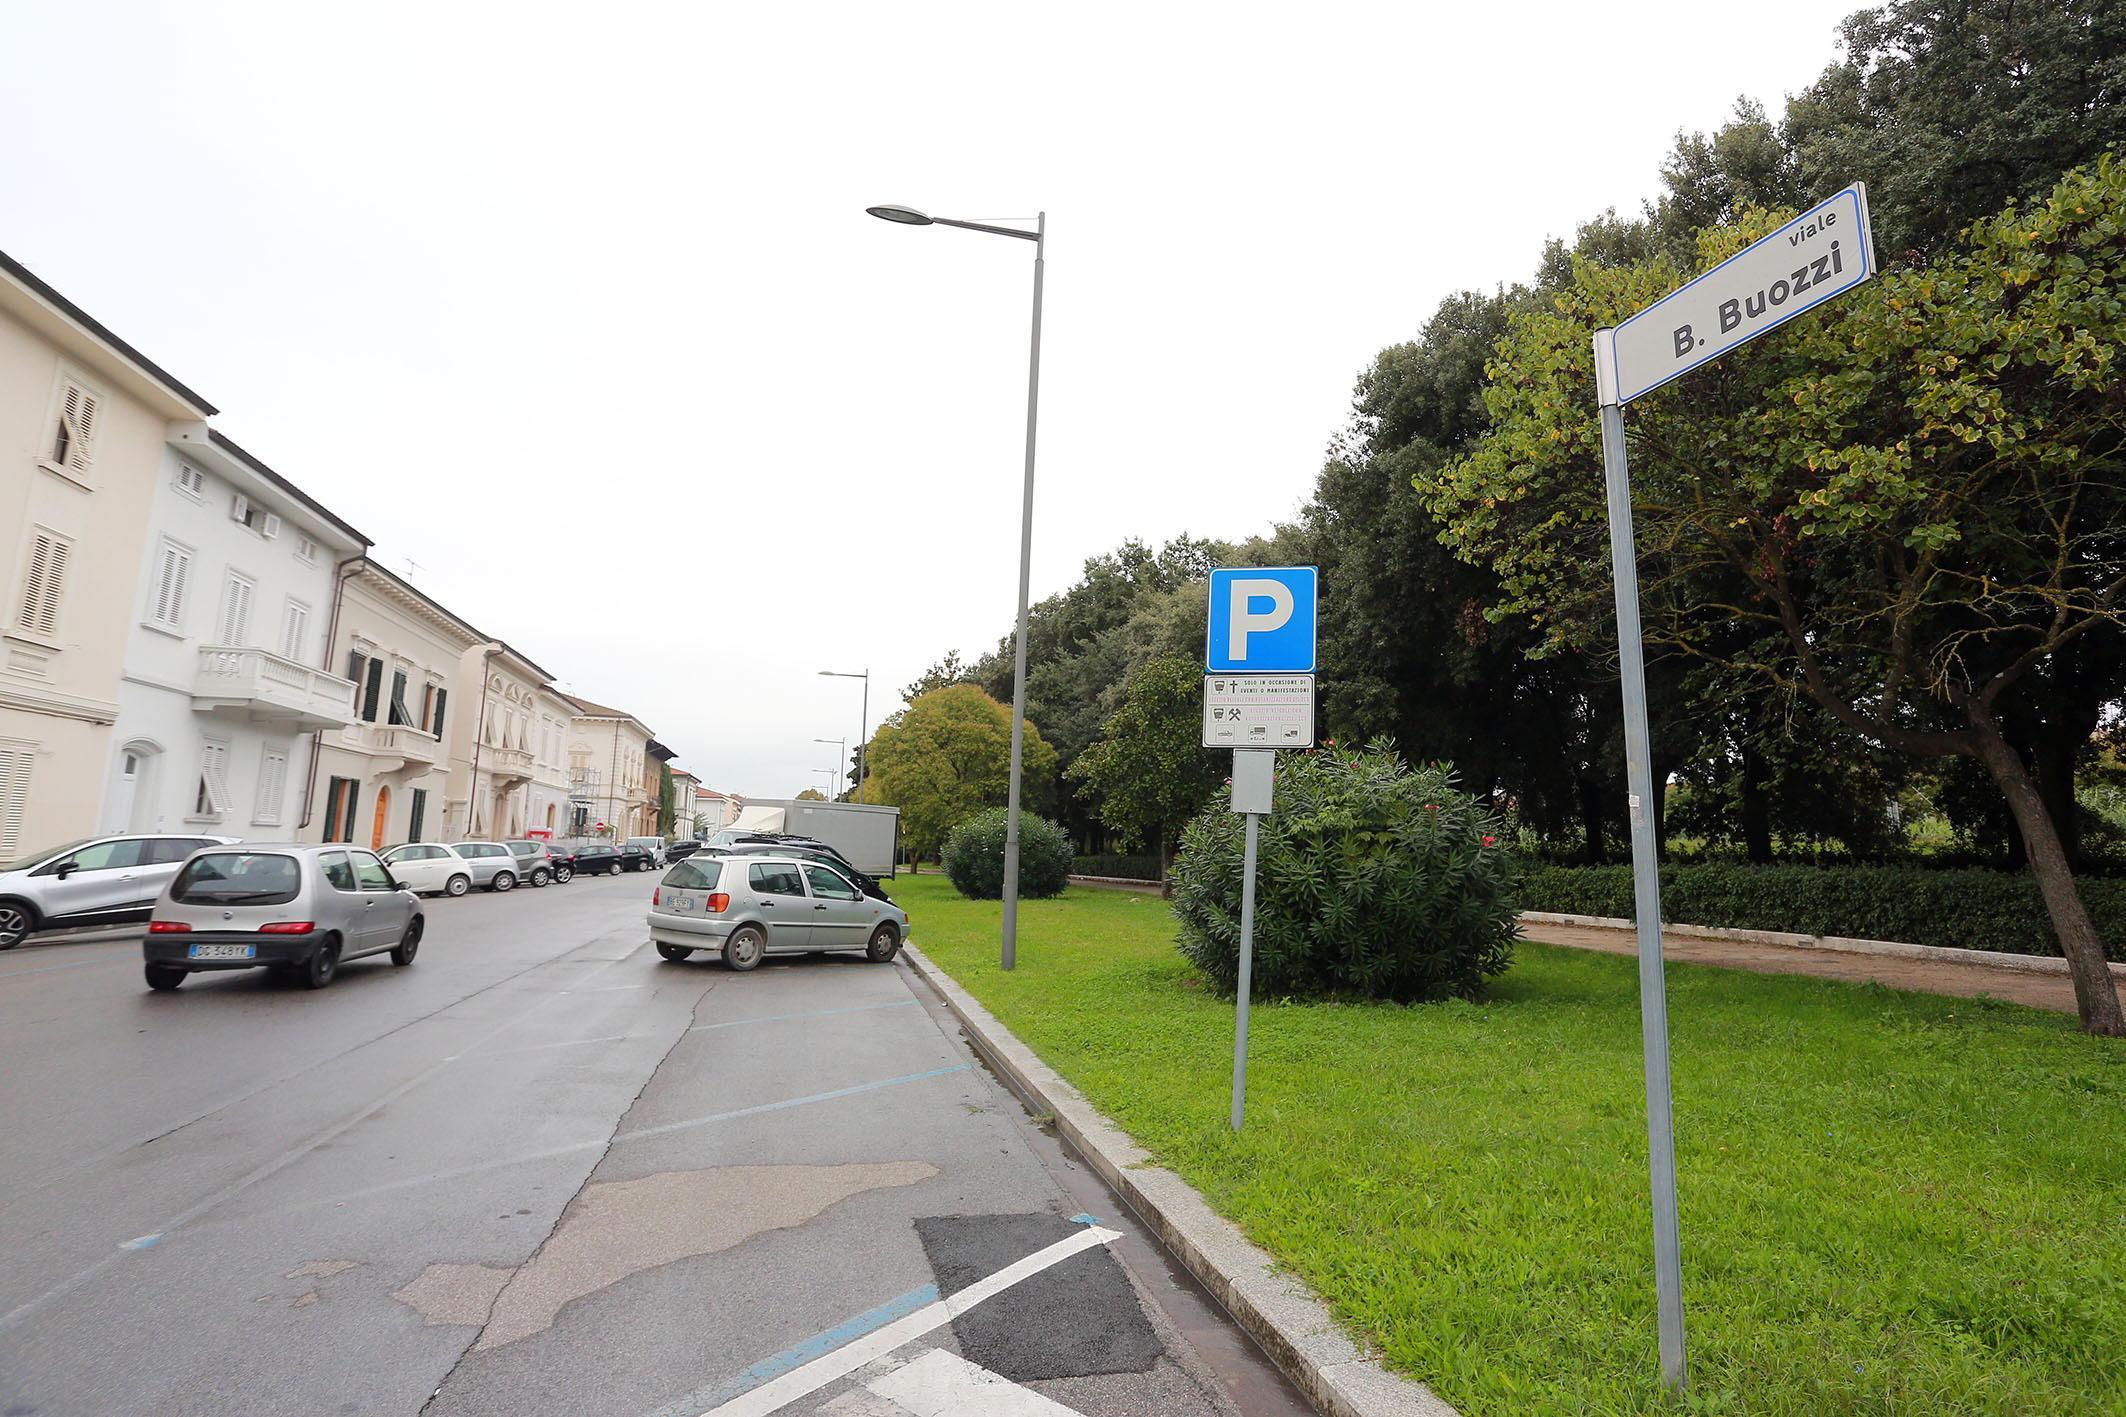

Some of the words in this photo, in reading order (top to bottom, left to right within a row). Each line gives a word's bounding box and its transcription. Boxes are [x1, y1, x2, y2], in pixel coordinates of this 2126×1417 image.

[1788, 211, 1837, 247] viale
[1673, 324, 1705, 358] B.
[1718, 240, 1843, 335] Buozzi
[1228, 578, 1294, 661] P
